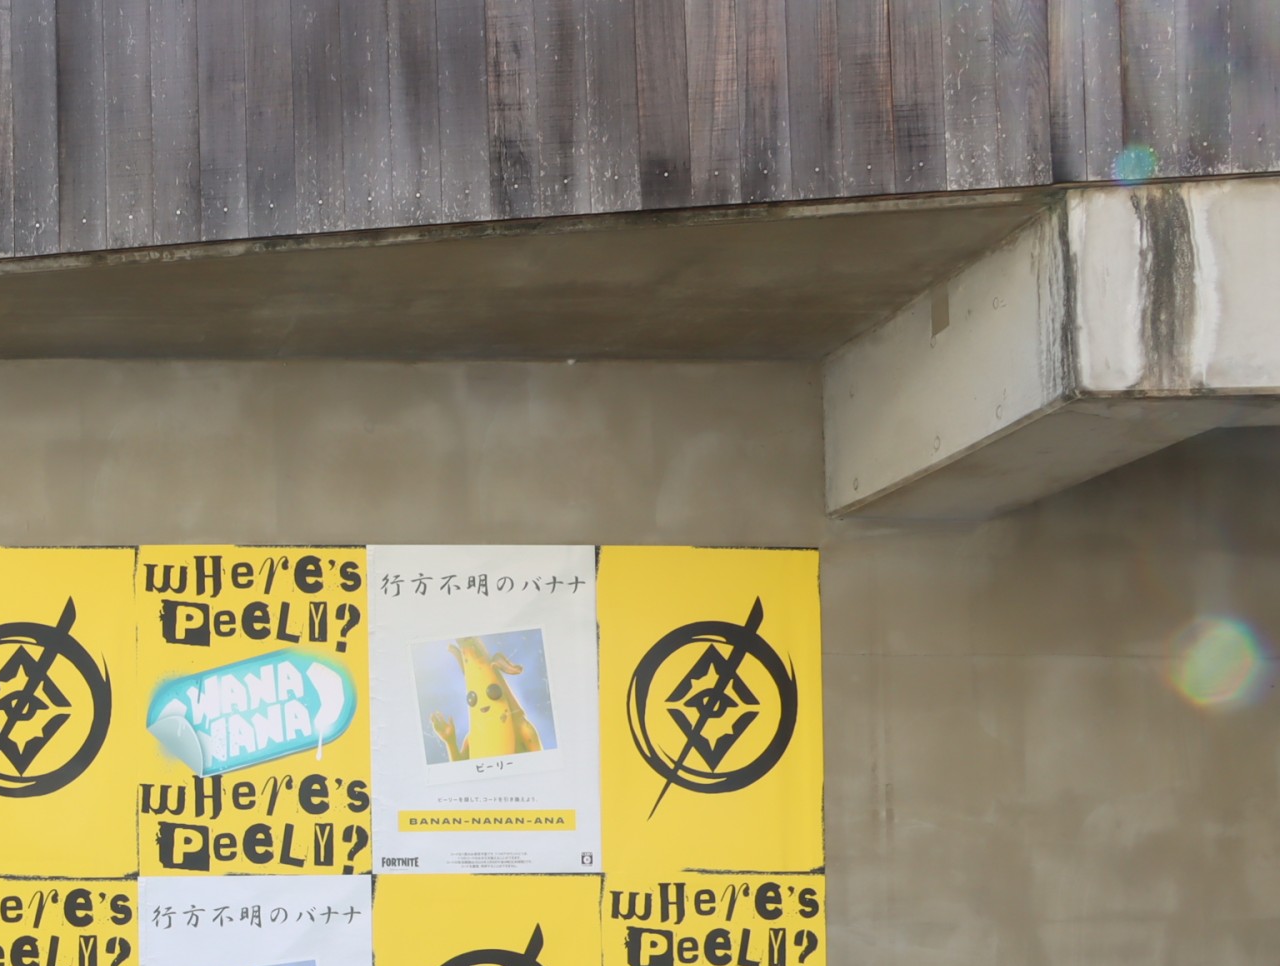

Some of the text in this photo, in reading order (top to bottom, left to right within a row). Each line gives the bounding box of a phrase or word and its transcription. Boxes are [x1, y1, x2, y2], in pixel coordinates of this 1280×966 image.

[380, 574, 587, 598] 行方不明のバナナ
[410, 816, 565, 825] BANAN-NANAN-ANA
[381, 856, 420, 868] FORTNITE
[151, 905, 362, 930] 行方不明のバナナ
